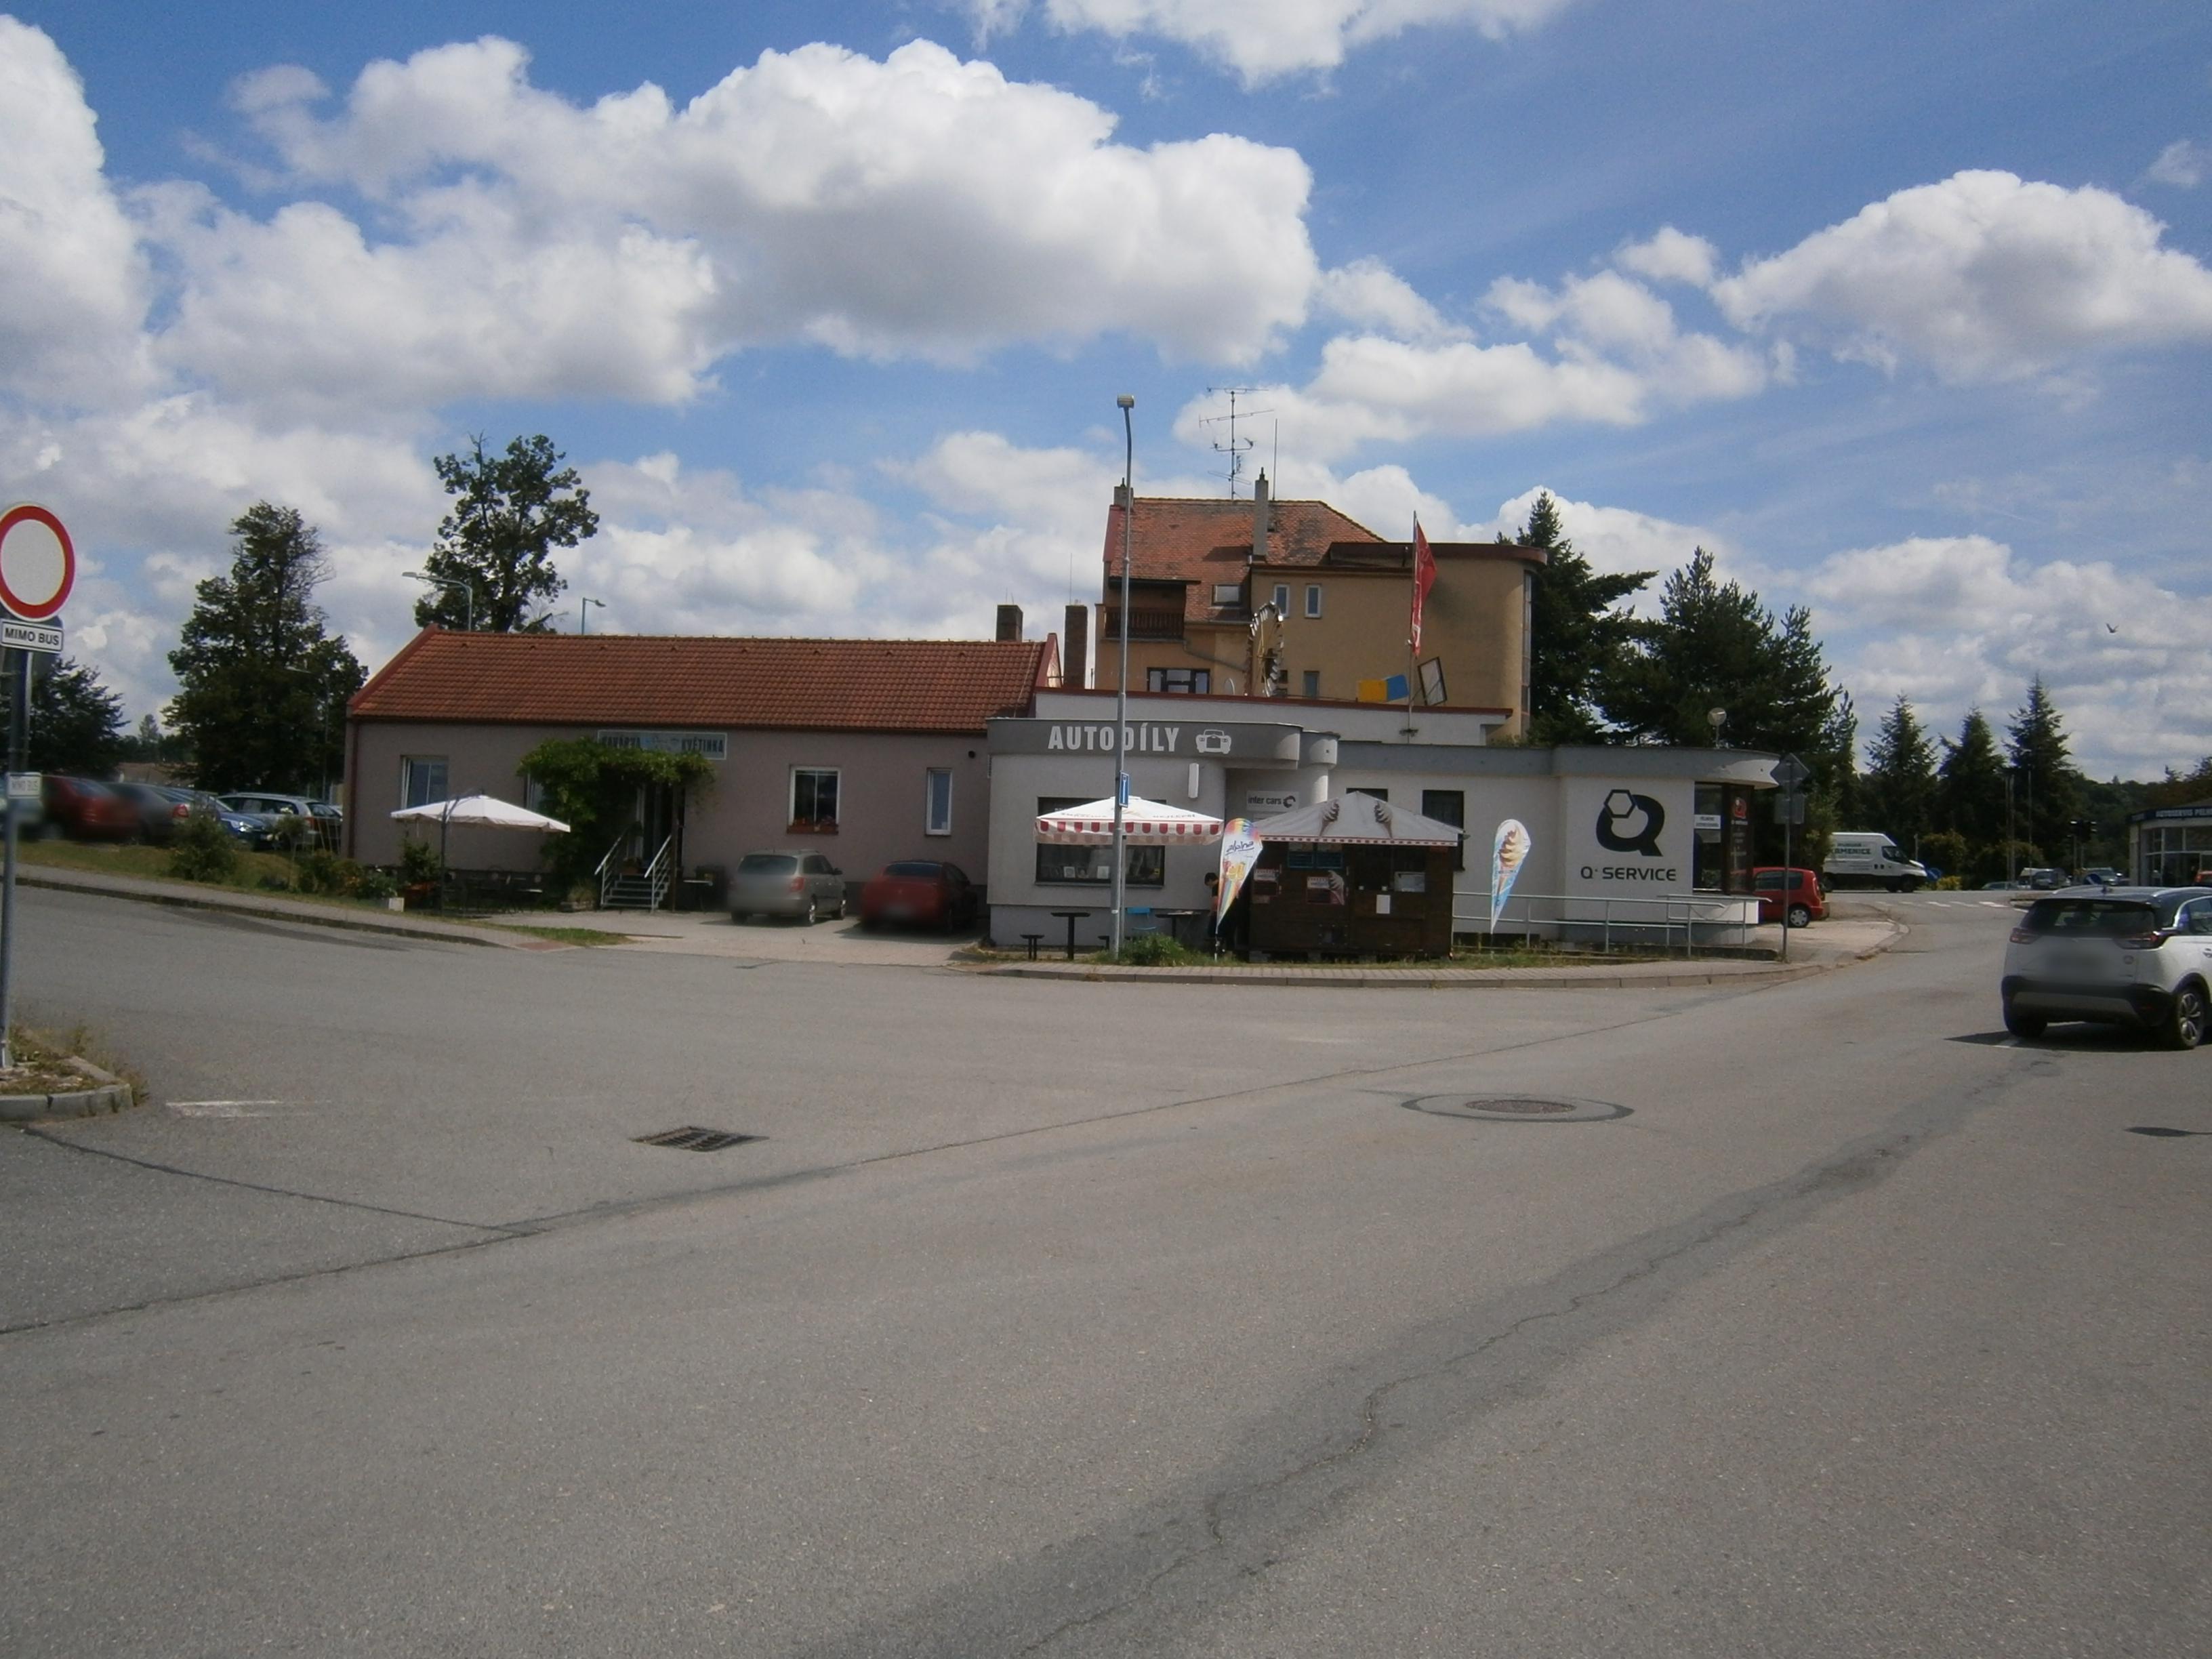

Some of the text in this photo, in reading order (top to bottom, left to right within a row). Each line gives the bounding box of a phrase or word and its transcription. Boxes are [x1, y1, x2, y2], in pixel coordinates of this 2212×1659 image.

[5, 628, 59, 645] MIMO BUS
[1048, 722, 1179, 752] AUTODÍLY
[1248, 796, 1264, 804] inter
[1602, 867, 1676, 881] SERVICE
